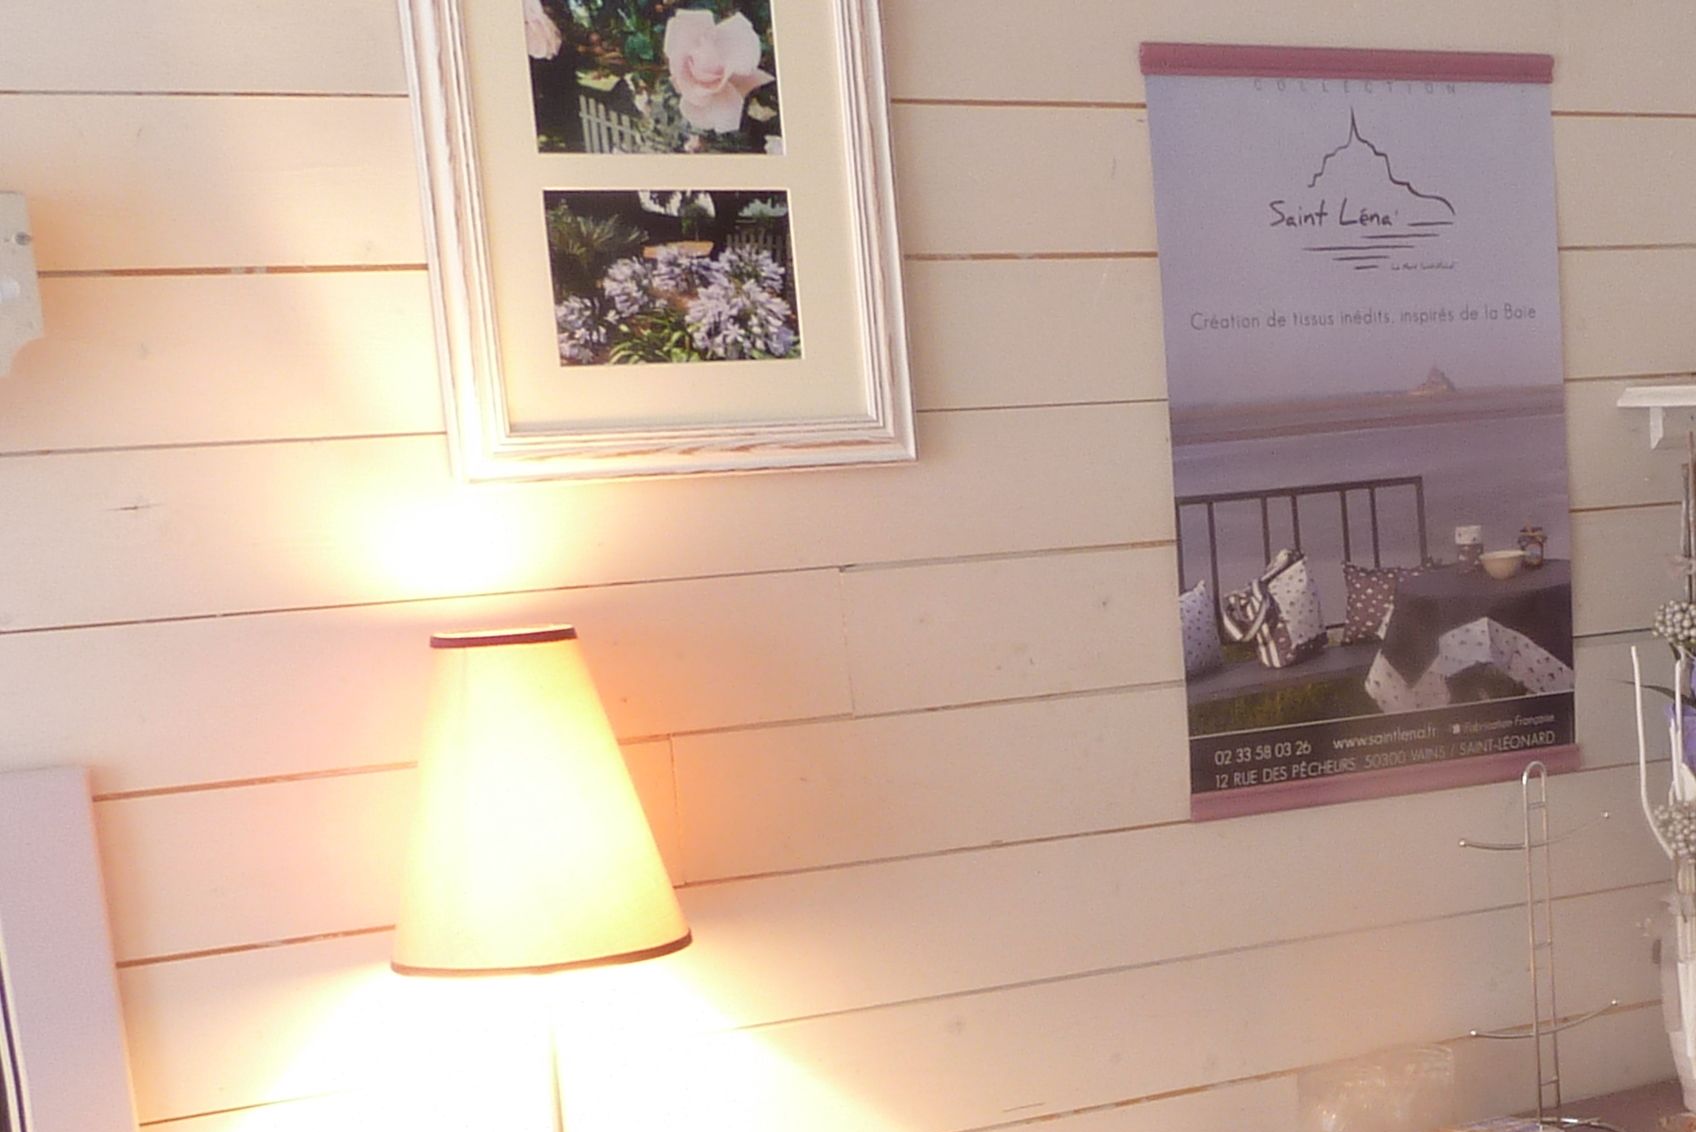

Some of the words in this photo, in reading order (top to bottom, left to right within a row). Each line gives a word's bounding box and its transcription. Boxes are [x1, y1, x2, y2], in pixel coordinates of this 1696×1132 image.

[1269, 199, 1328, 227] Saint
[1190, 310, 1260, 331] Création
[1266, 309, 1286, 328] de
[1292, 311, 1334, 327] tissus
[1400, 307, 1454, 325] inspirés
[1459, 304, 1479, 321] de
[1484, 303, 1498, 320] la
[1504, 302, 1536, 320] Baie
[1214, 750, 1232, 766] 02
[1236, 747, 1252, 763] 33
[1255, 744, 1272, 760] 58
[1274, 742, 1292, 758] 03
[1295, 740, 1312, 756] 26
[1215, 774, 1229, 788] 12
[1233, 770, 1258, 786] RUE
[1262, 765, 1288, 783] DES
[1291, 757, 1356, 779] PÊCHEURS
